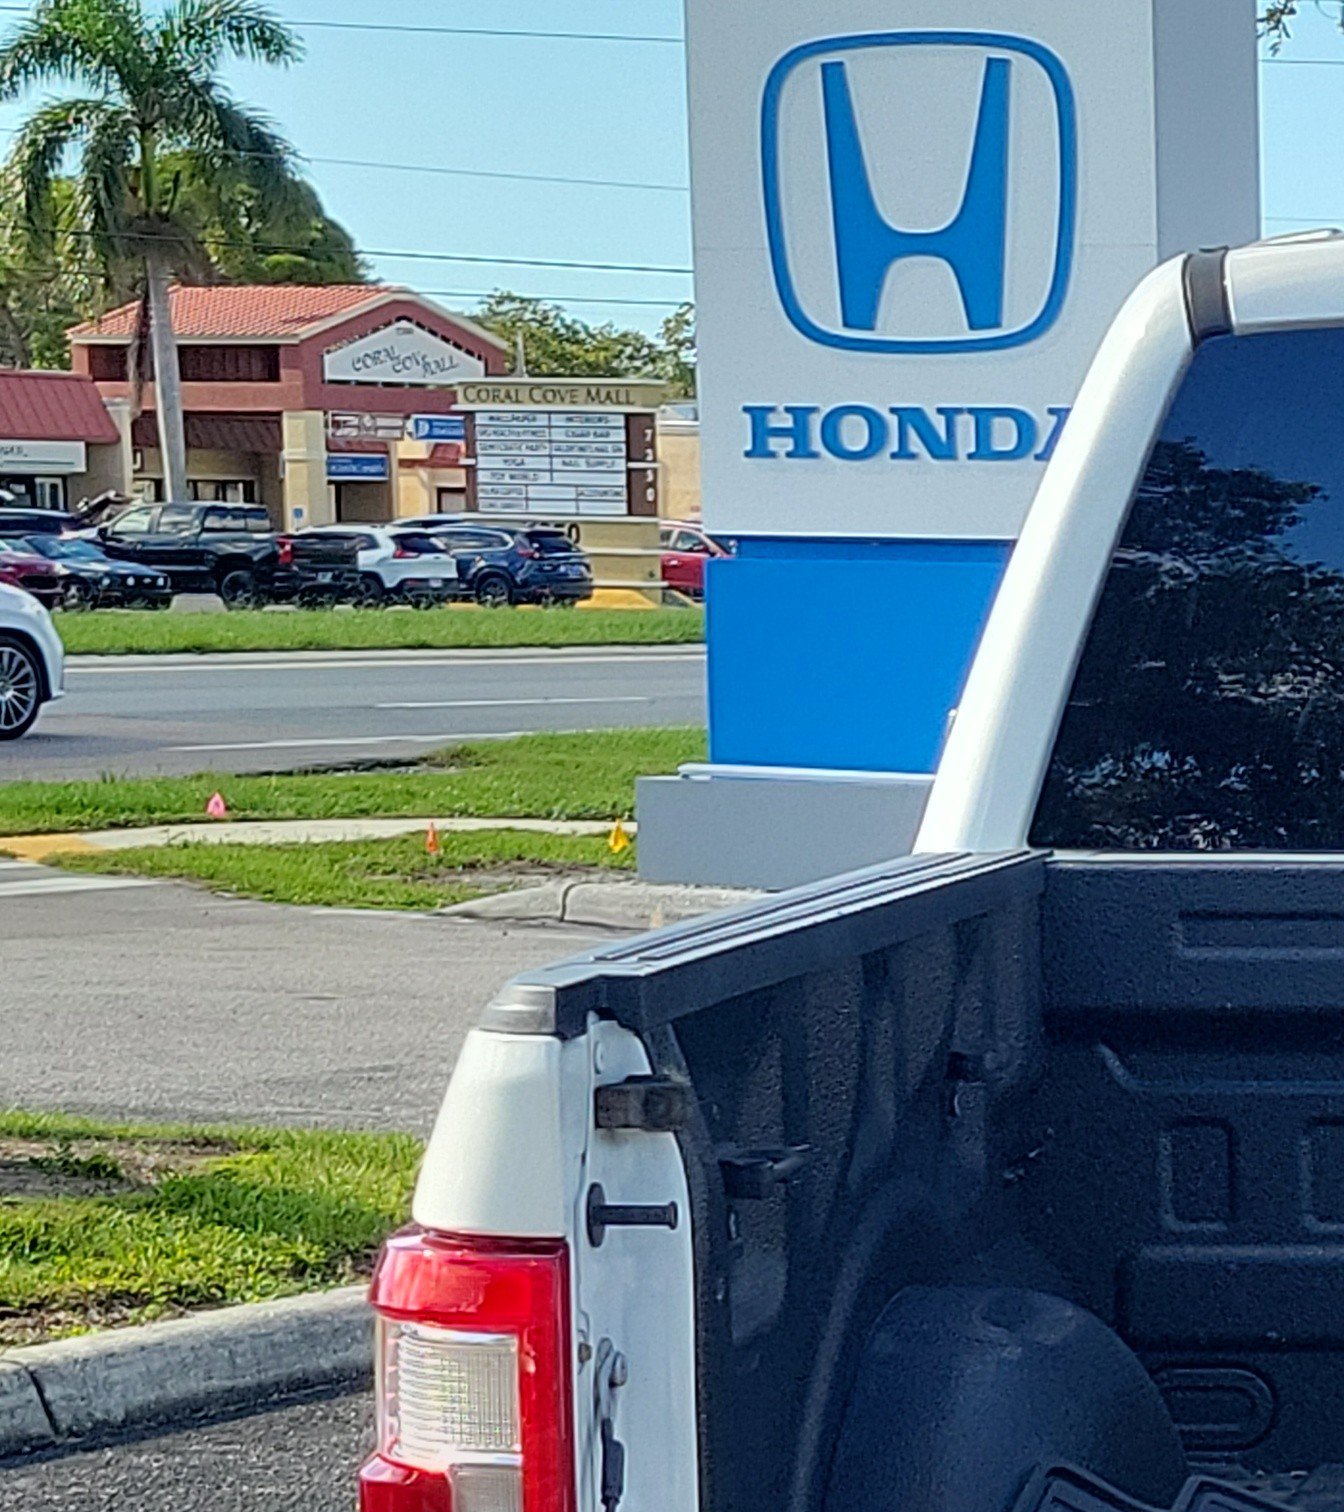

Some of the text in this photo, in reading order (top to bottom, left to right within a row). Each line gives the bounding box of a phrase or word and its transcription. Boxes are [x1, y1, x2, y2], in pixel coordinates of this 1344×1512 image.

[463, 384, 635, 405] CORAL COVE MALL
